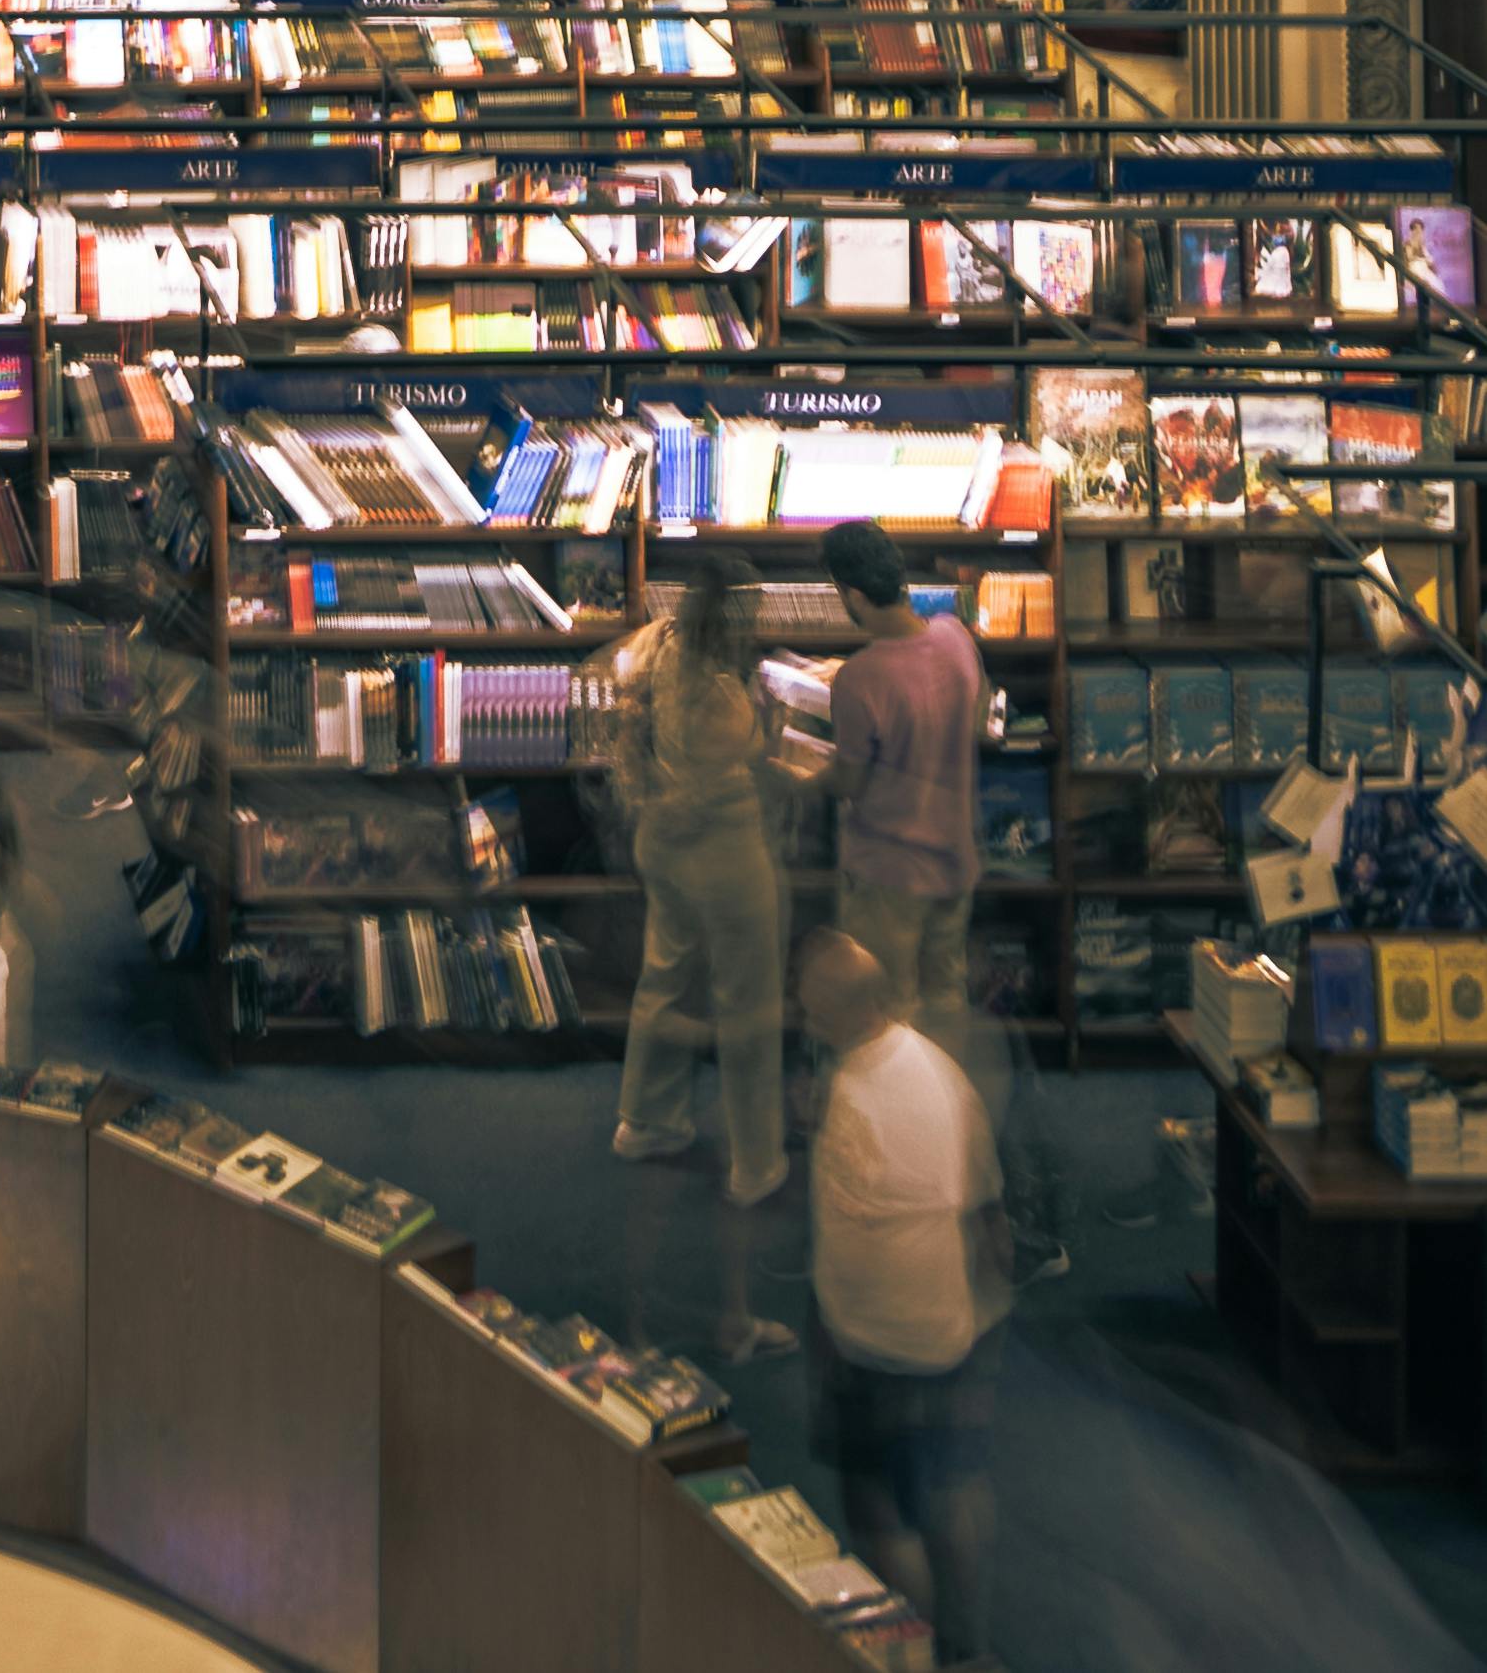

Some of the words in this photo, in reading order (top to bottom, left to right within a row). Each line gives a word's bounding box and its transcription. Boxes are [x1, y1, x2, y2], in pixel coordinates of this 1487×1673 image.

[181, 159, 239, 180] ARTE
[895, 162, 953, 183] ARTE
[1256, 166, 1314, 186] ARTE
[352, 383, 467, 407] TURISMO
[764, 392, 882, 414] TURISMO
[1068, 389, 1123, 408] JAPAN
